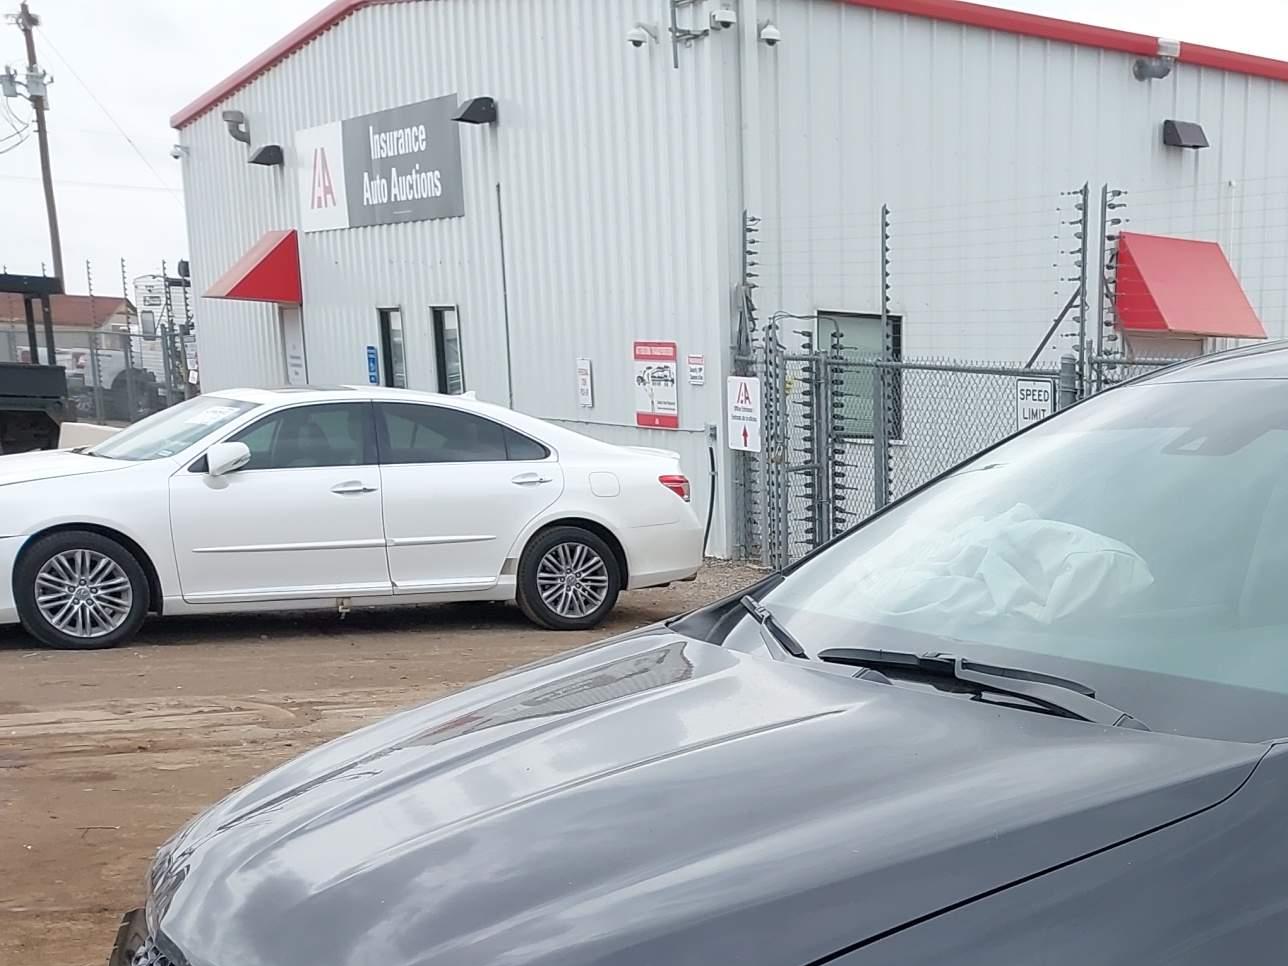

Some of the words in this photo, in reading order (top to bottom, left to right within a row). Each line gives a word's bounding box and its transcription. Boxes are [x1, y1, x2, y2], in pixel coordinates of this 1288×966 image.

[369, 124, 427, 160] Insurance
[363, 171, 389, 206] Auto
[391, 164, 442, 202] Auctions
[1019, 388, 1049, 402] SPEED
[1022, 407, 1046, 420] LIMIT
